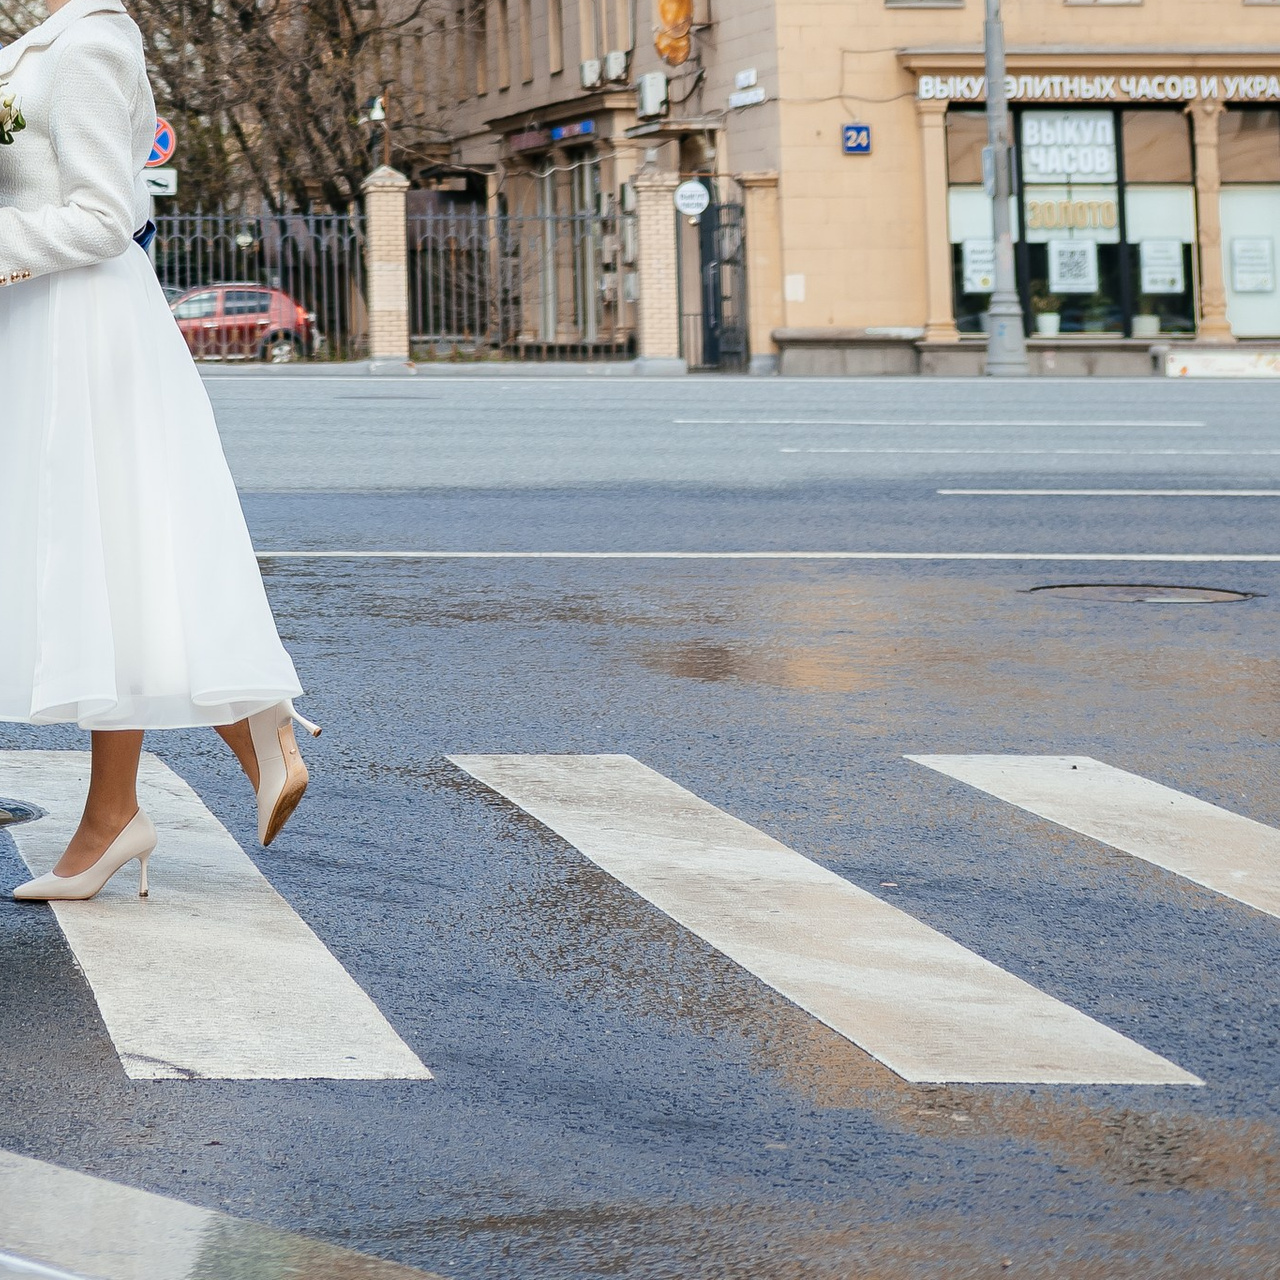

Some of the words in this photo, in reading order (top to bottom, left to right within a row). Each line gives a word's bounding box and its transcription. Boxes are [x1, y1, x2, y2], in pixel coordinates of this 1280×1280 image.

[919, 75, 989, 99] ВЫКУ
[1004, 75, 1116, 99] ЭЛИТНЫХ
[1120, 75, 1197, 100] ЧАСОВ
[1200, 75, 1218, 99] И
[846, 130, 868, 147] 24
[1022, 119, 1114, 146] ВЫКУП
[1029, 146, 1111, 173] ЧАСОВ
[1028, 200, 1117, 229] ЗОЛОТО
